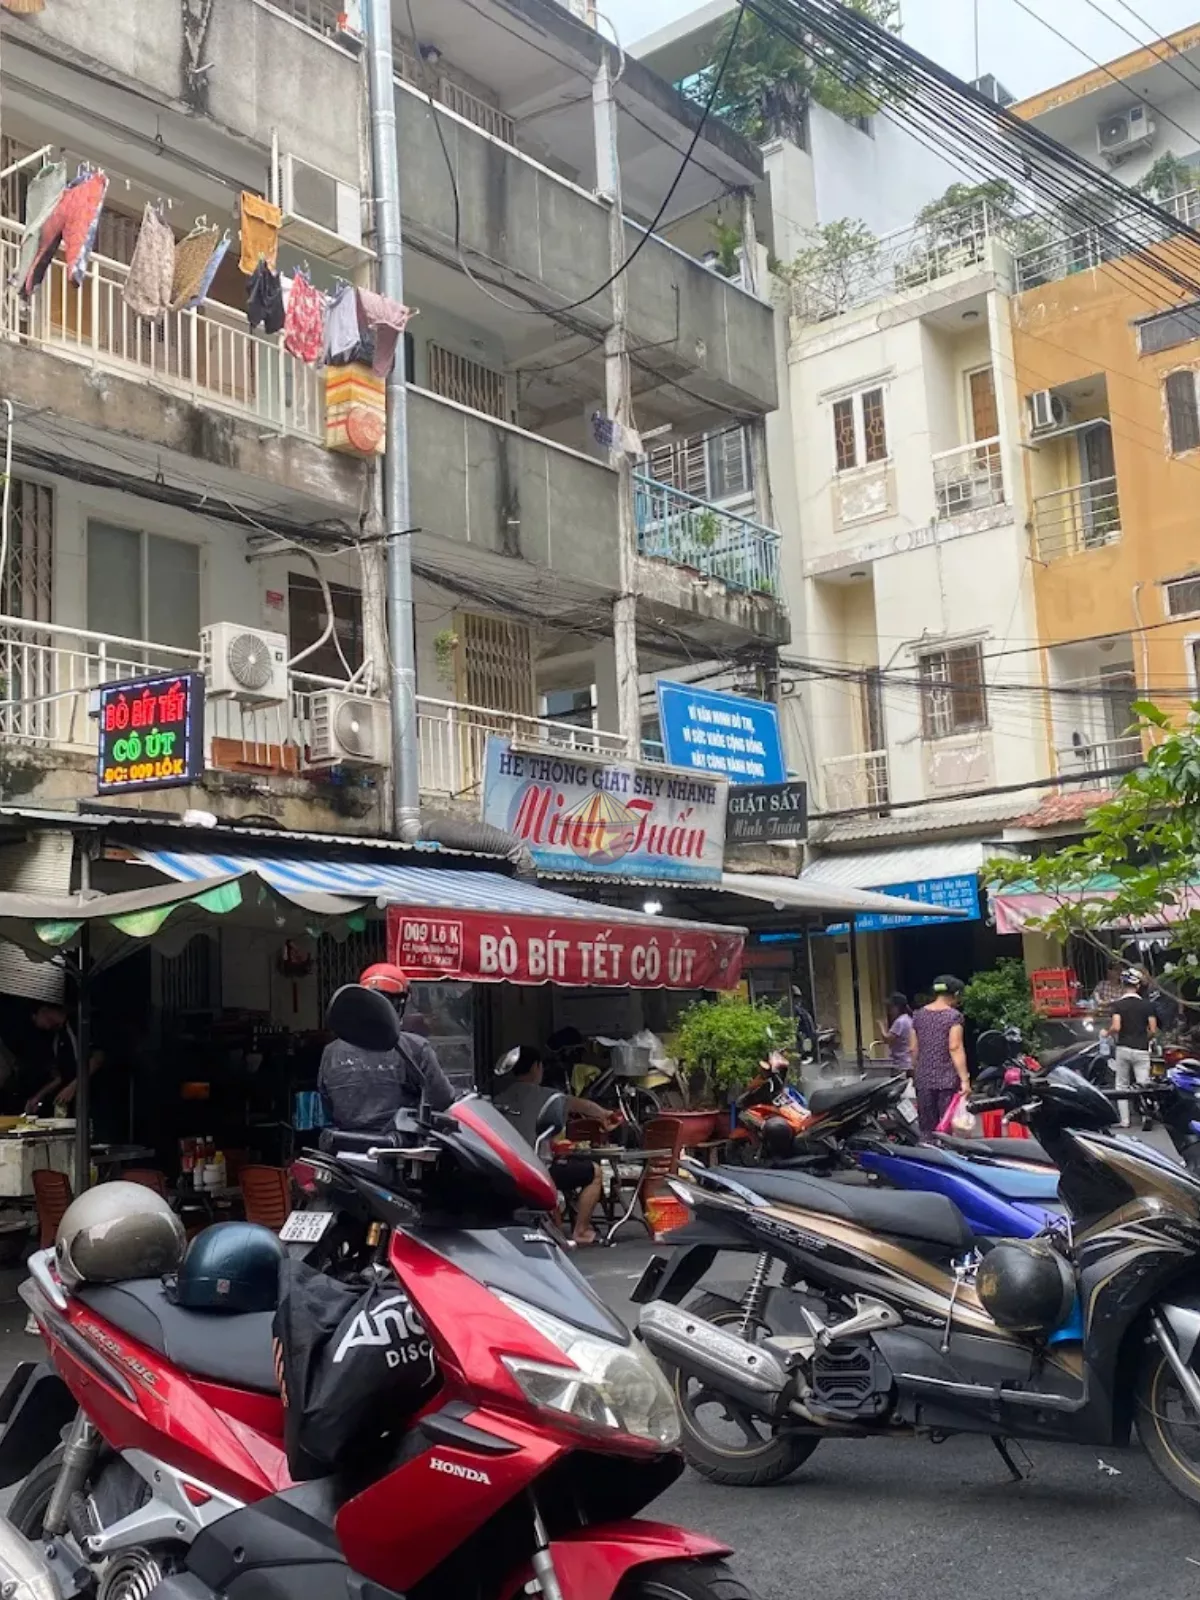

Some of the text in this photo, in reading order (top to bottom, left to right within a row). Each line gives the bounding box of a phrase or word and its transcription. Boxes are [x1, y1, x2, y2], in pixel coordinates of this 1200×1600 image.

[106, 680, 186, 731] BÒ BÍT TẾT
[113, 727, 176, 762] CÔ ÚT
[129, 763, 154, 779] 009
[729, 786, 801, 816] GIẶT SẤY
[623, 798, 706, 859] Tuấn
[403, 922, 459, 943] 009 Lô K
[479, 925, 696, 982] BÒ BÍT TẾT CÔ ÚT
[429, 1457, 492, 1485] HONDA
